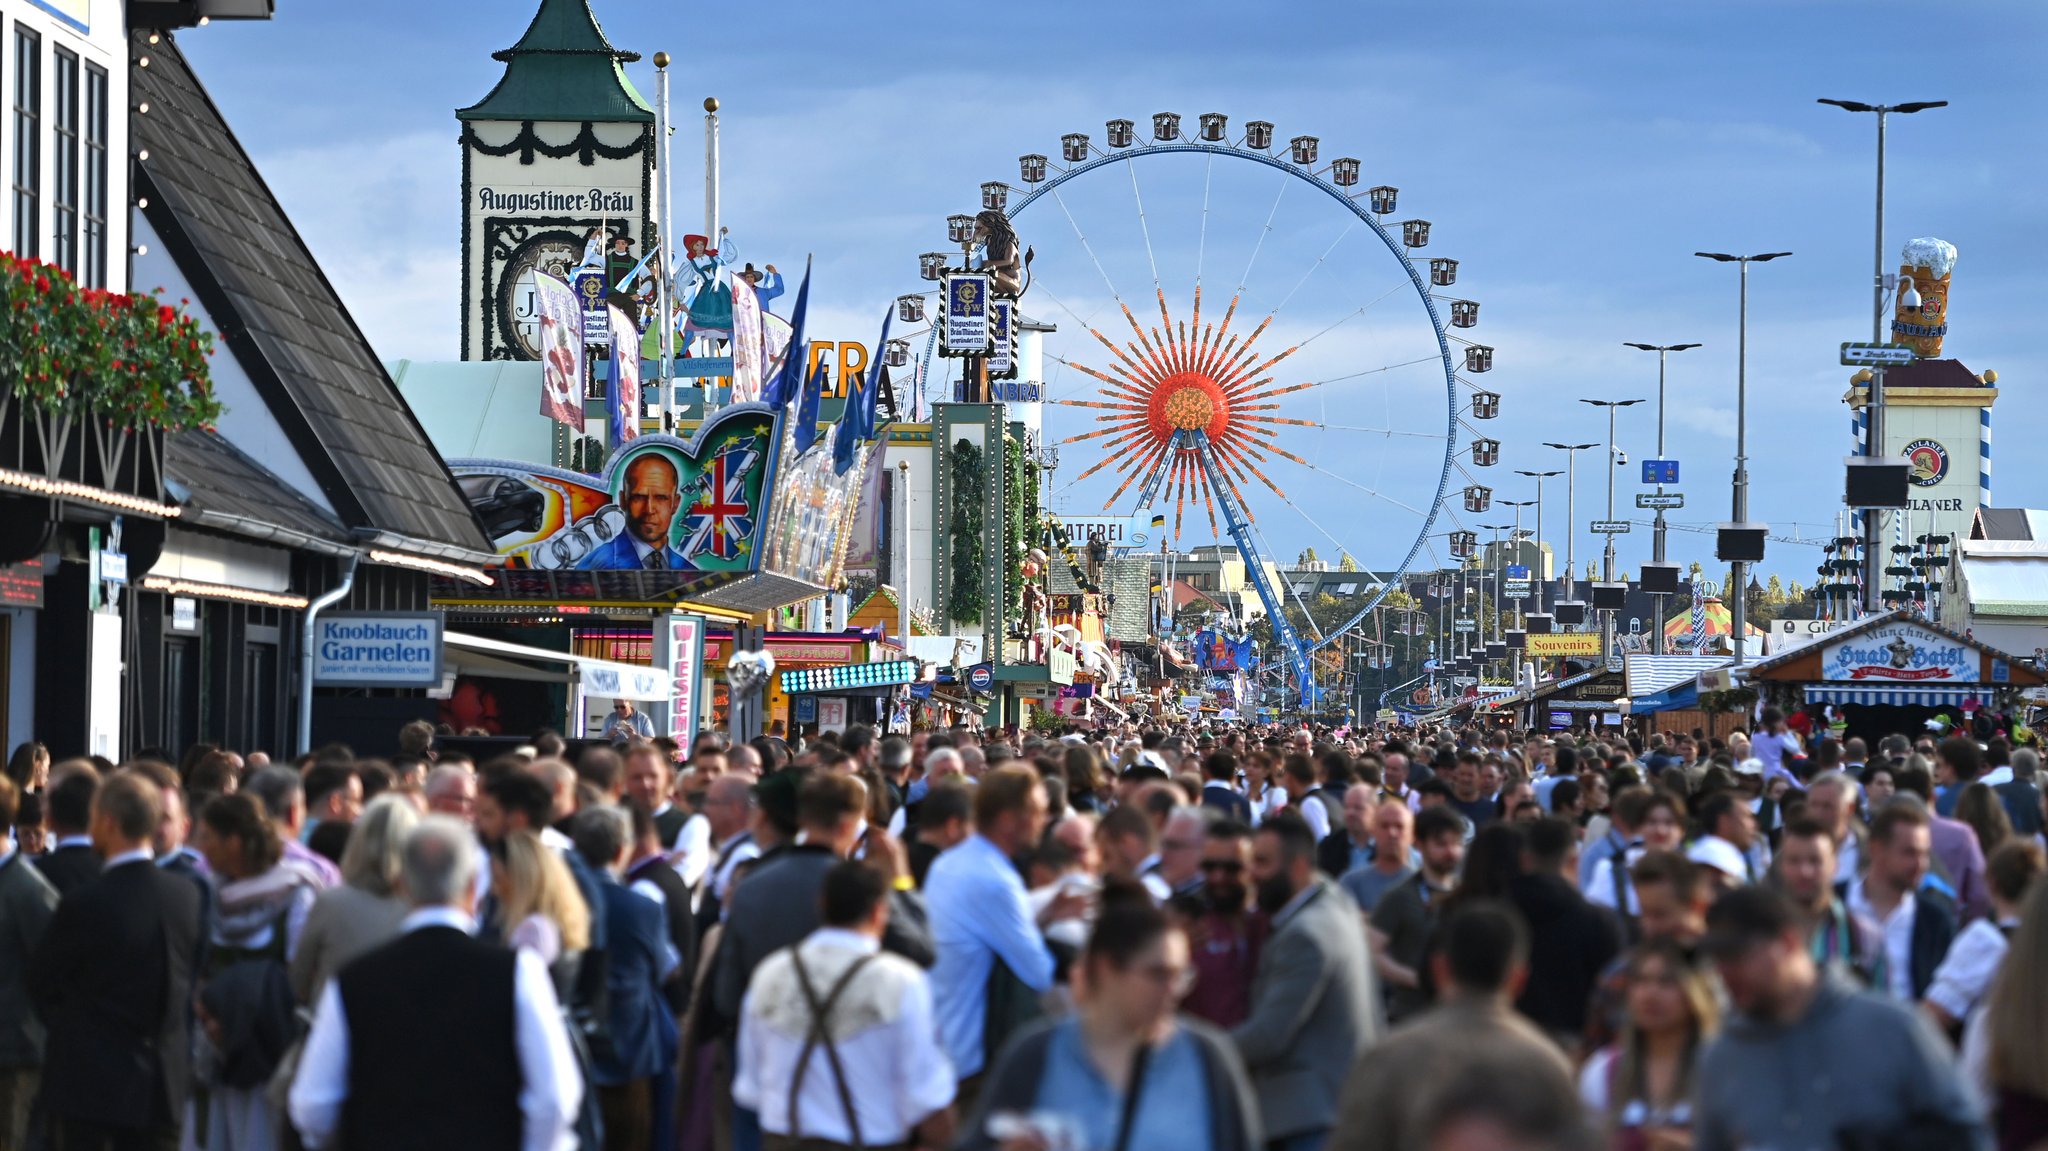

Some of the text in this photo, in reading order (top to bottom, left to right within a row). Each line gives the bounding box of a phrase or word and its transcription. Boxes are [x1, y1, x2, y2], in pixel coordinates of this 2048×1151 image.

[1903, 440, 1946, 458] PAULANER
[1904, 499, 1962, 512] ULANER
[1066, 524, 1123, 541] ATEREI
[324, 622, 428, 640] Knoblauch
[1865, 627, 1940, 644] Münchner
[321, 641, 431, 662] Garnelen
[1534, 639, 1593, 651] Souvenirs
